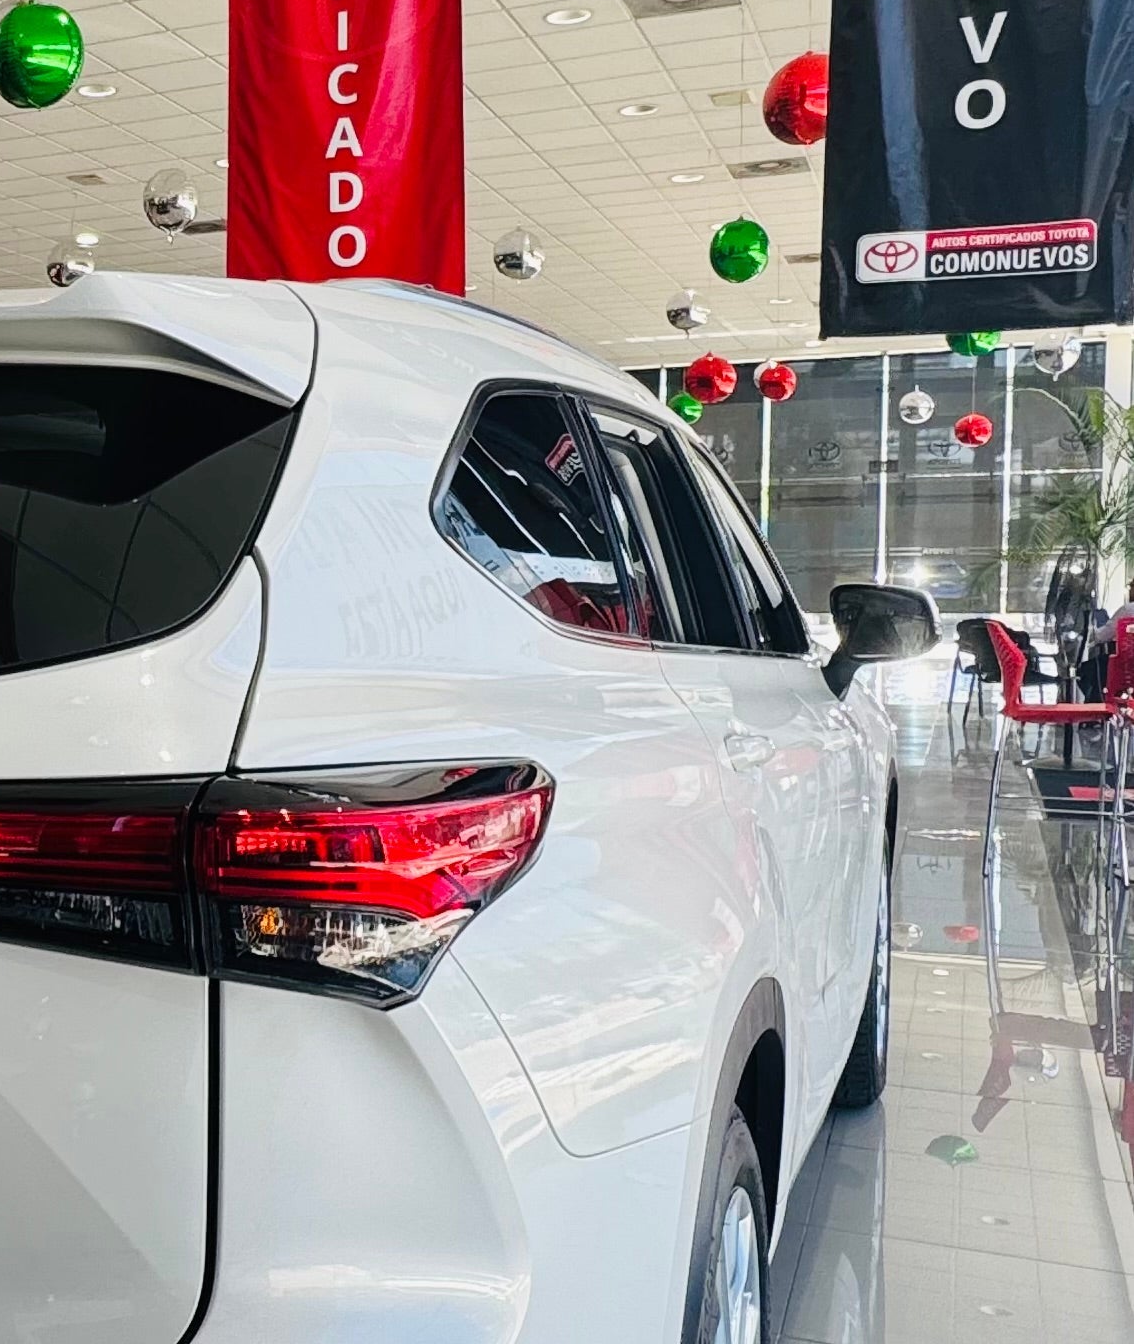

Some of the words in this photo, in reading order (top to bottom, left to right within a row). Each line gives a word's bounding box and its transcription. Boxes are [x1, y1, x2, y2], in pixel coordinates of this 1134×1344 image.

[931, 235, 967, 248] AUTOS
[969, 229, 1046, 246] CERTIFICADOS
[1049, 226, 1090, 240] TOYOTA
[930, 243, 1089, 275] COMONUEVOS
